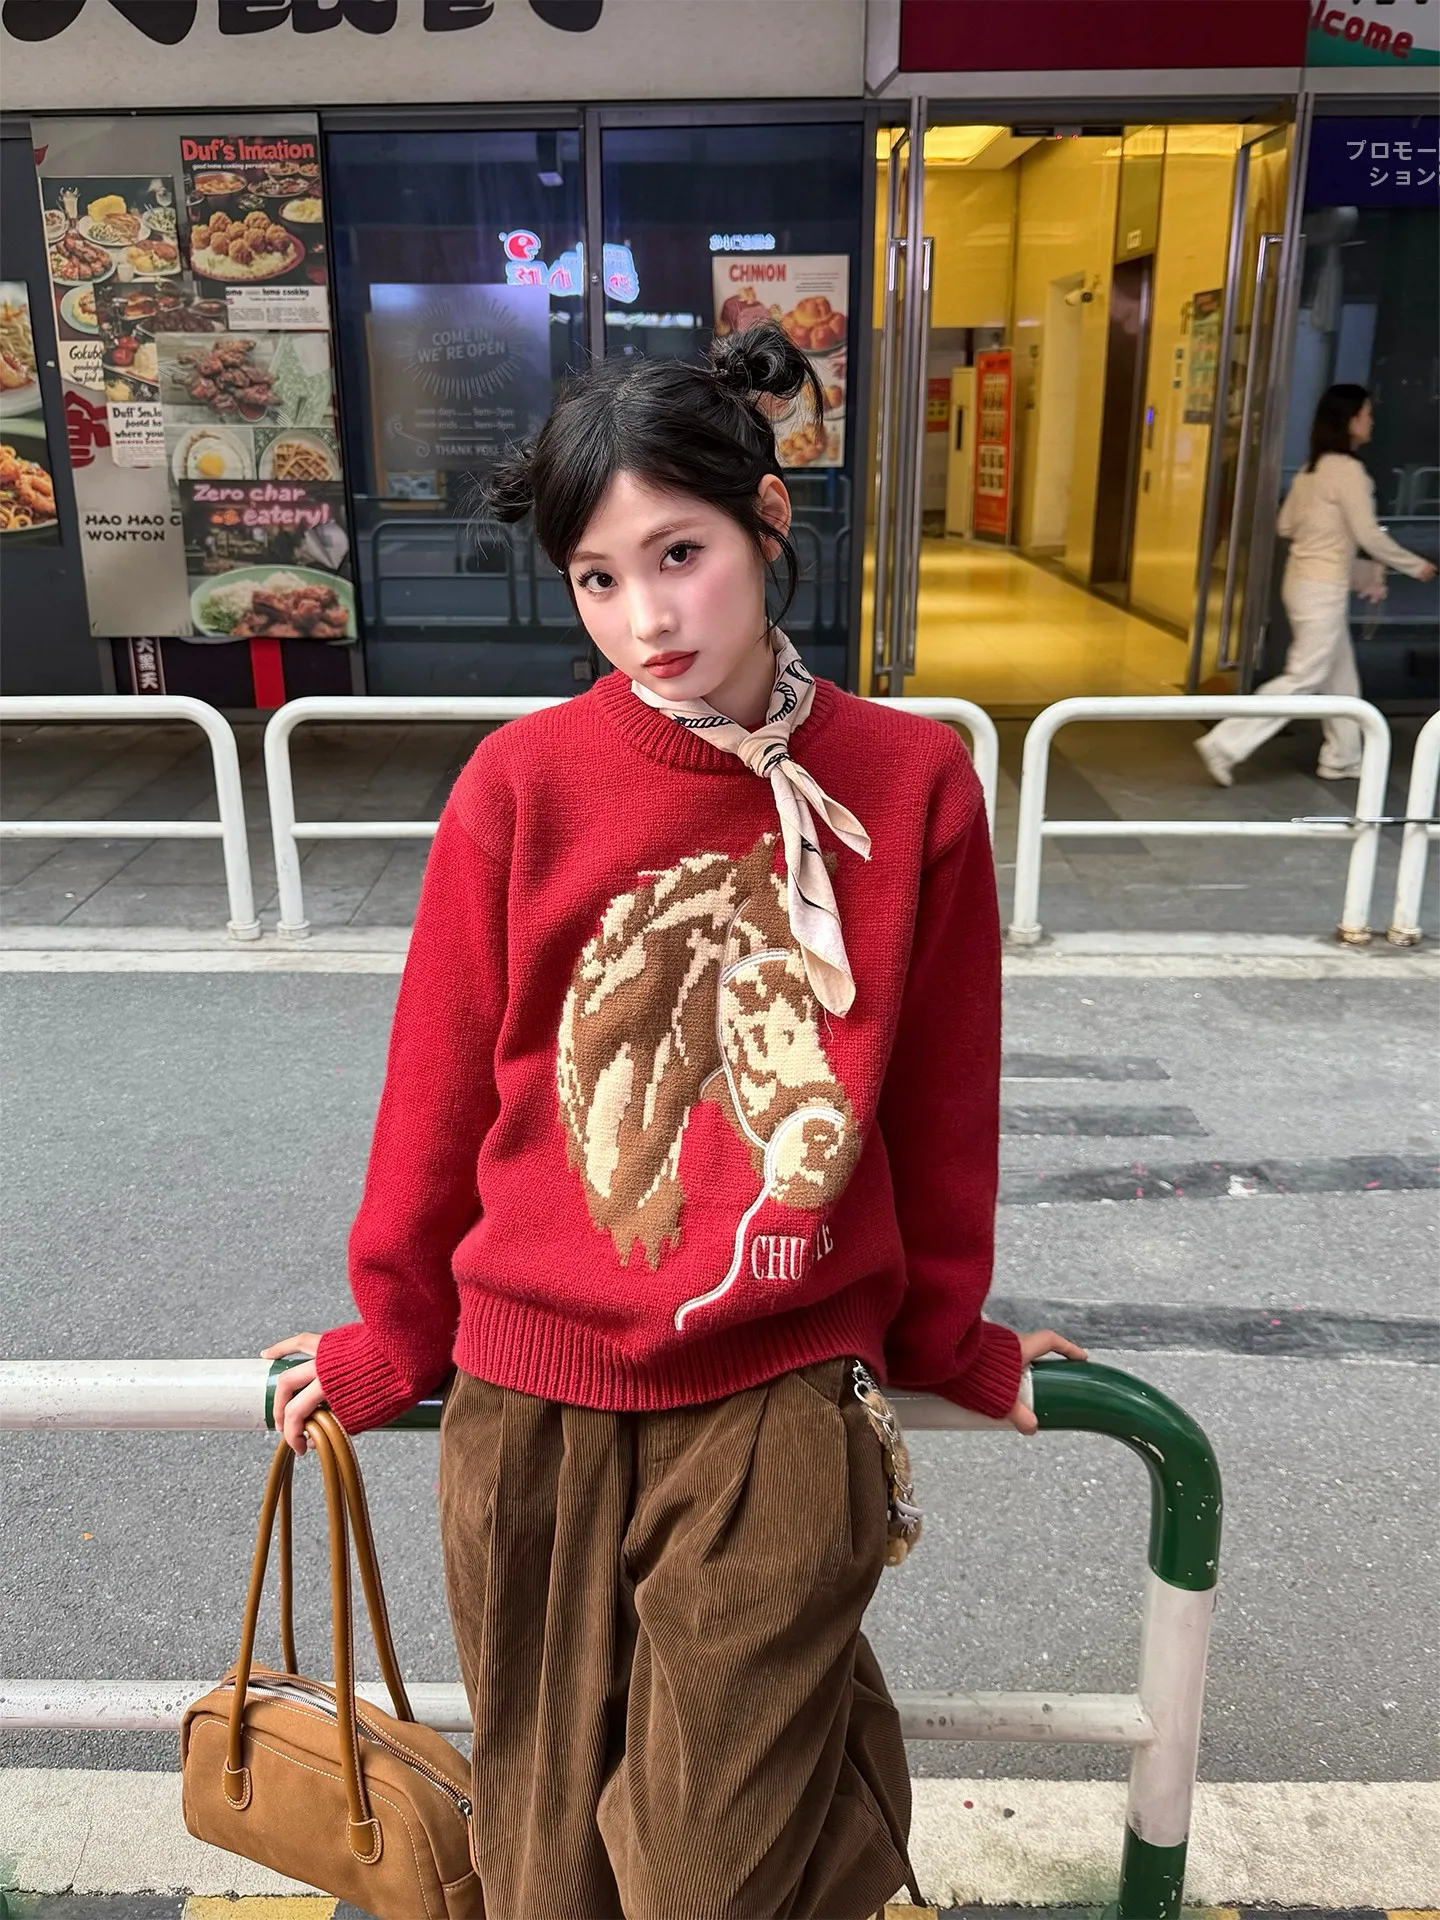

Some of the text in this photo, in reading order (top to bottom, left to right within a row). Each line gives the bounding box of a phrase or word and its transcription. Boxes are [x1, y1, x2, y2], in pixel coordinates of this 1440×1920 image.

[1346, 139, 1437, 161] プロモー
[1369, 166, 1436, 187] ション
[433, 331, 472, 346] COME
[466, 341, 505, 358] OPEN
[193, 483, 306, 502] Zero char
[85, 514, 122, 526] HAO
[127, 514, 165, 526] HAO
[87, 530, 165, 541] WONTON
